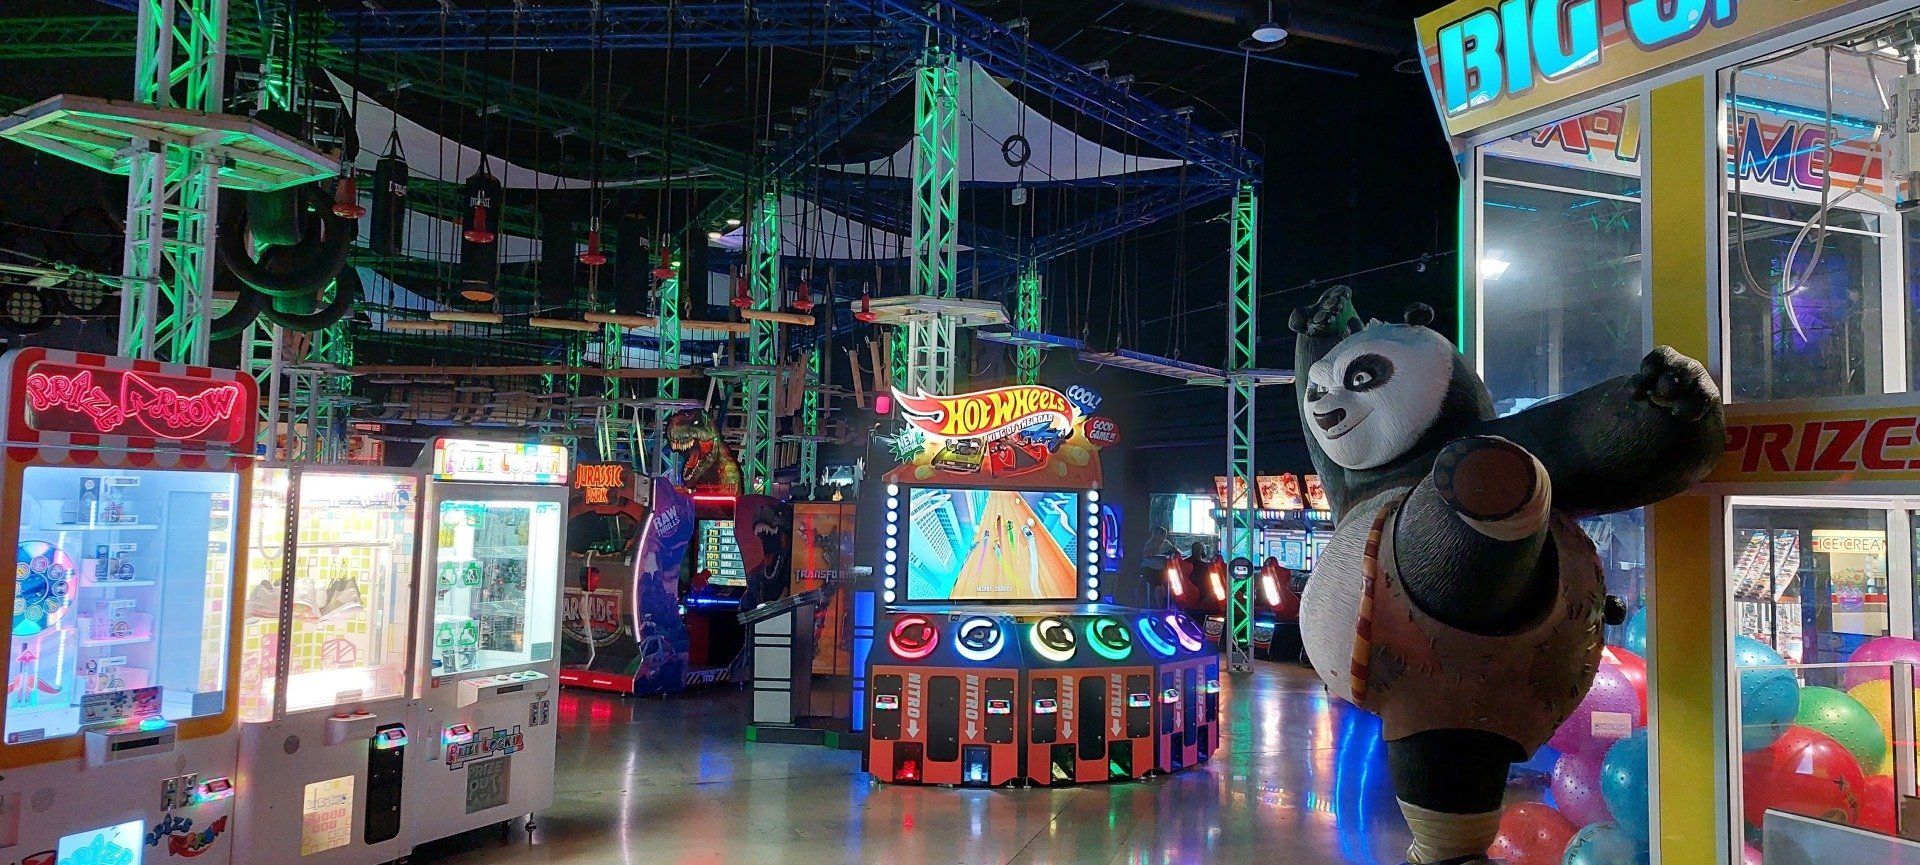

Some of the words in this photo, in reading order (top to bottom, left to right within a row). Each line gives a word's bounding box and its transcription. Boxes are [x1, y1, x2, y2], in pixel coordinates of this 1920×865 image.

[1437, 0, 1603, 118] BIG
[27, 370, 124, 433] PRIZE
[1068, 384, 1103, 409] COOL!
[987, 428, 1006, 443] KING
[1006, 424, 1017, 435] OF
[1016, 418, 1033, 430] THE
[1032, 413, 1054, 424] ROAD
[1093, 419, 1115, 432] GOOD
[574, 463, 624, 489] JURASSIC
[585, 486, 609, 504] PARK
[652, 505, 677, 531] RAW
[655, 517, 681, 537] THRILLS
[1818, 537, 1840, 550] ICE
[907, 672, 921, 720] NITRO
[965, 673, 979, 721] NITRO
[1062, 675, 1074, 720] NITRO
[1110, 673, 1122, 718] NITRO
